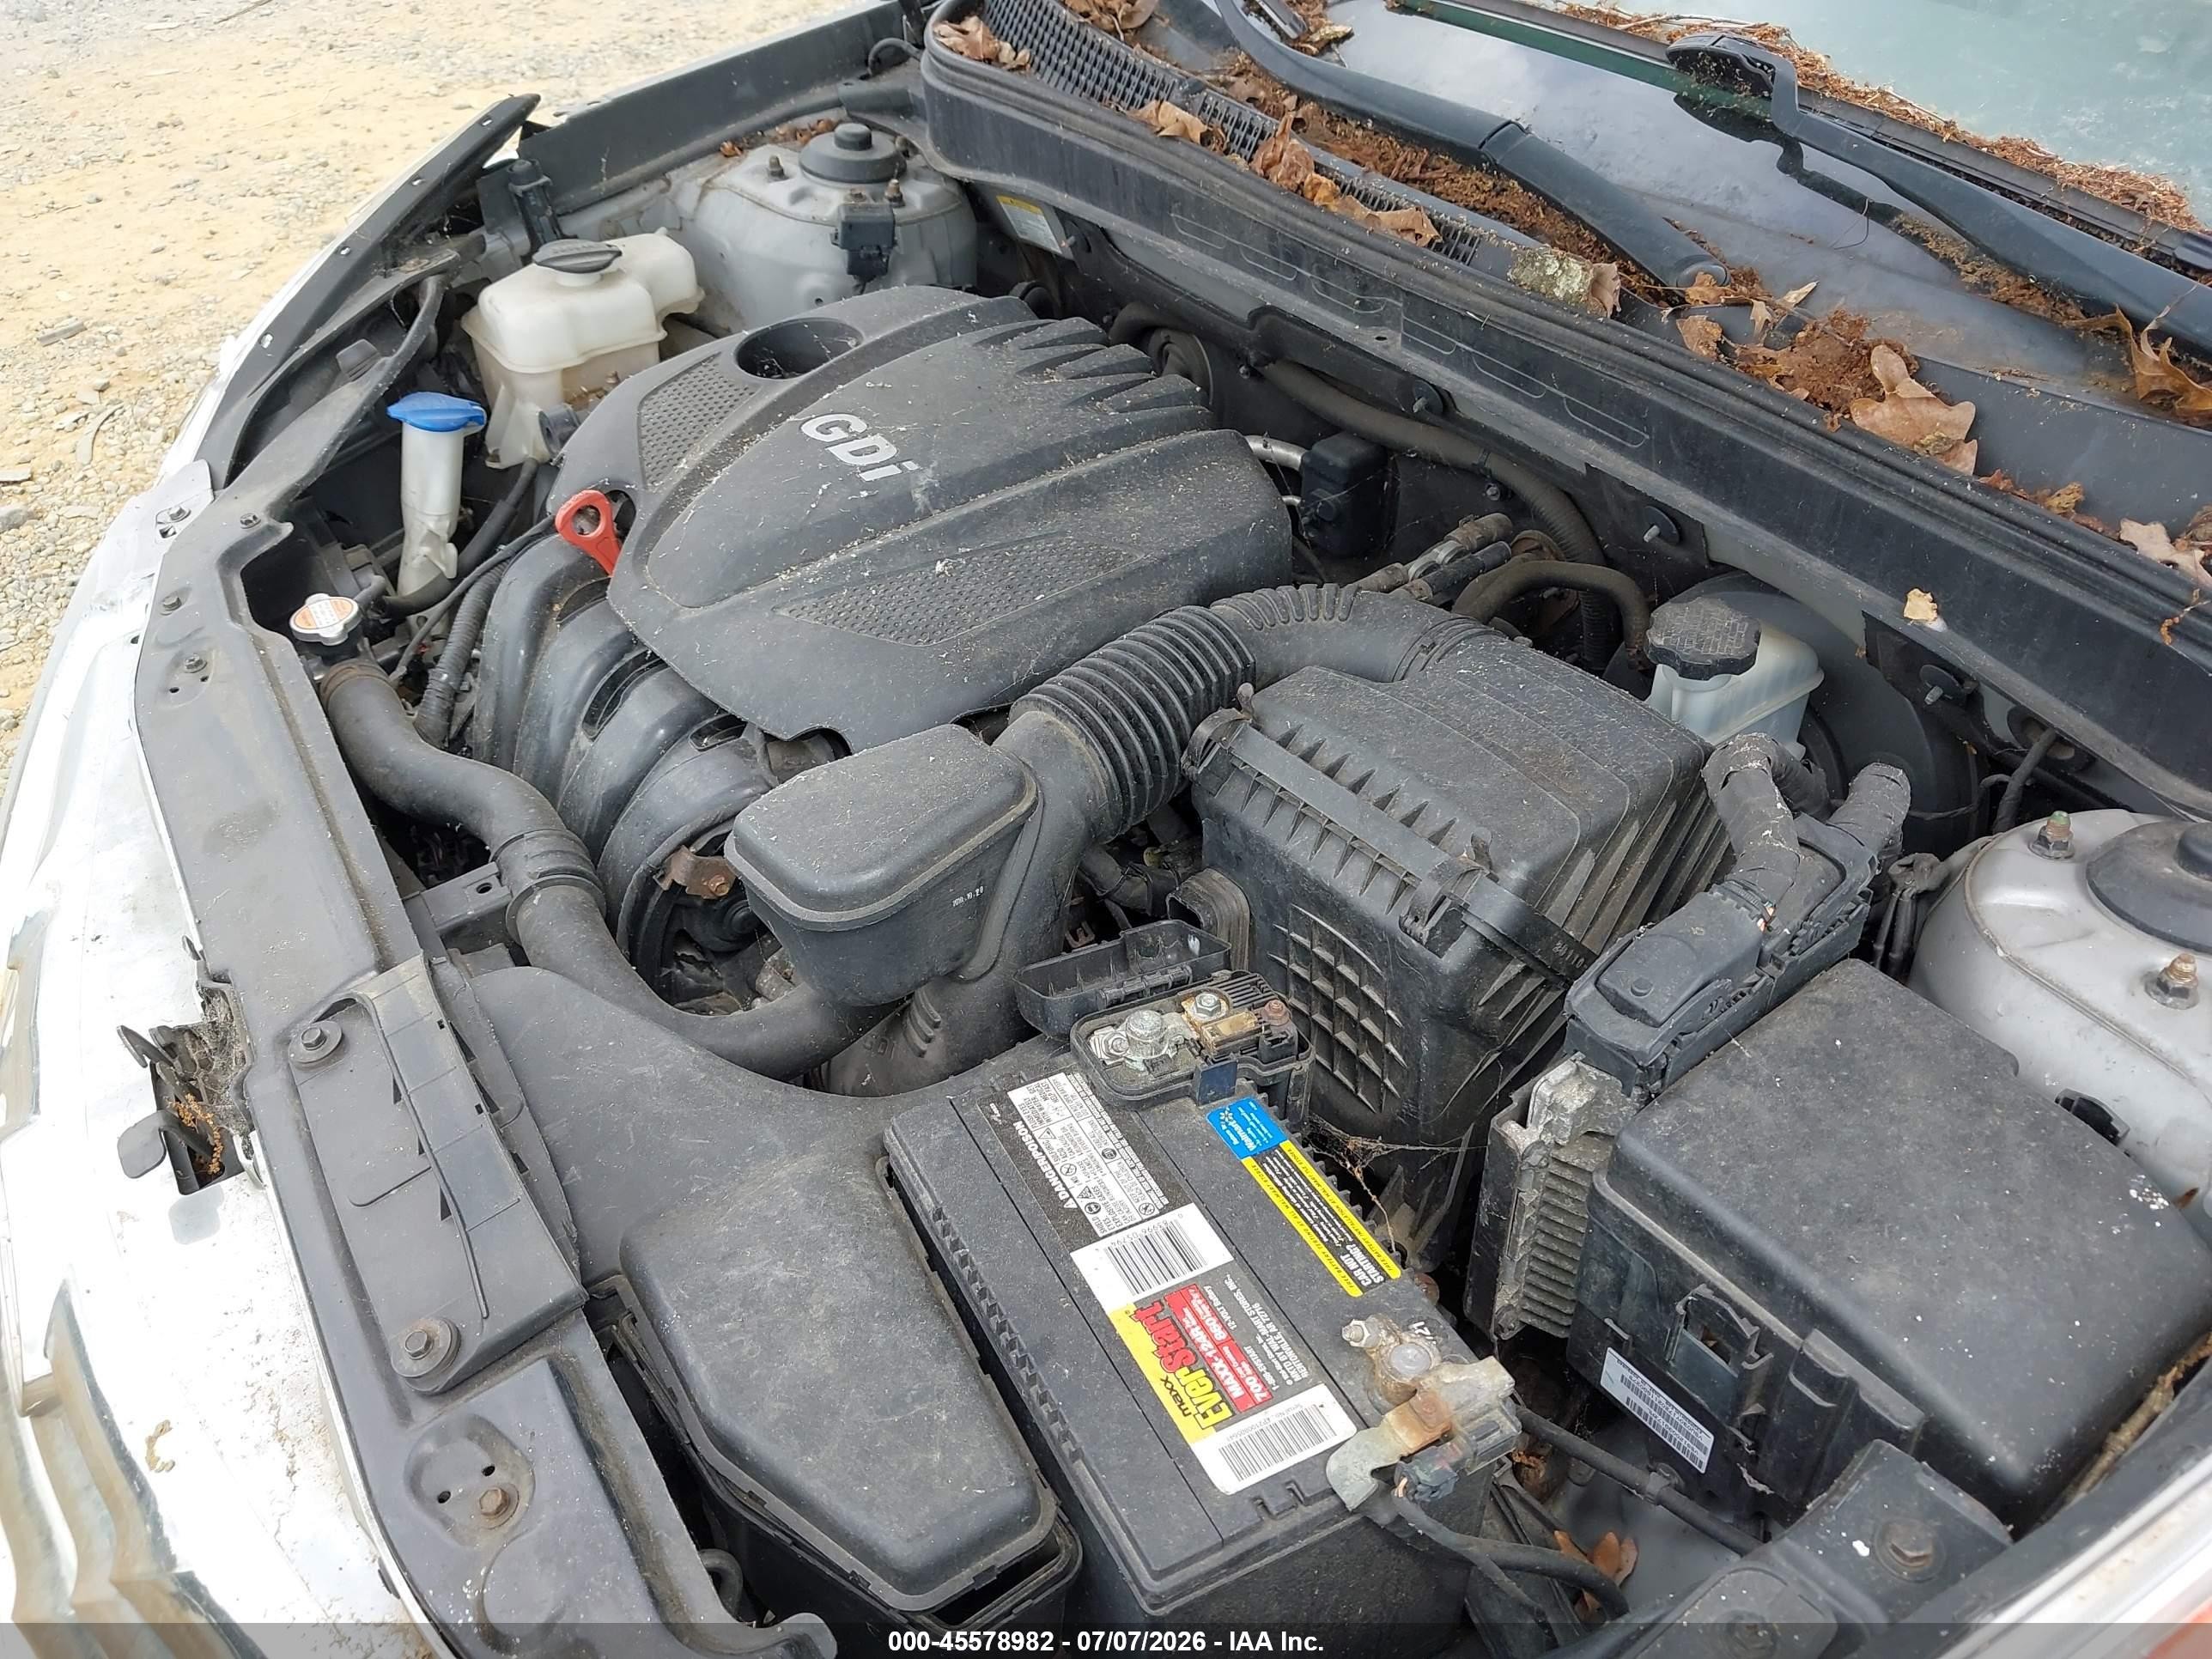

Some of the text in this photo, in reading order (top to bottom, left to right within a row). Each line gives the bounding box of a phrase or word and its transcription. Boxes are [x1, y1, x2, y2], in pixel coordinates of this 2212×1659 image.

[800, 414, 920, 482] GDi
[1226, 1119, 1258, 1151] Walmart
[1011, 1120, 1071, 1200] DANGER/POISON
[1101, 1200, 1123, 1227] EXPLOSIVE
[1288, 1211, 1297, 1219] ALL
[1334, 1204, 1364, 1237] INSTALLATION
[1302, 1227, 1322, 1249] TESTING
[1361, 1236, 1382, 1258] BATTERY
[1321, 1250, 1342, 1273] BATTERY
[1339, 1251, 1372, 1287] CAR NOT
[1344, 1241, 1385, 1285] STARTING?
[1379, 1258, 1393, 1272] FREE
[1340, 1274, 1353, 1288] FREE
[1215, 1304, 1238, 1330] 12-VOLT
[1264, 1321, 1278, 1334] AR
[1249, 1315, 1281, 1352] WAL-MART
[1187, 1324, 1246, 1399] MAXX-124R
[1274, 1349, 1288, 1362] BY
[1281, 1359, 1302, 1382] MKTD
[1158, 1375, 1192, 1417] maxx
[1242, 1373, 1271, 1402] 700
